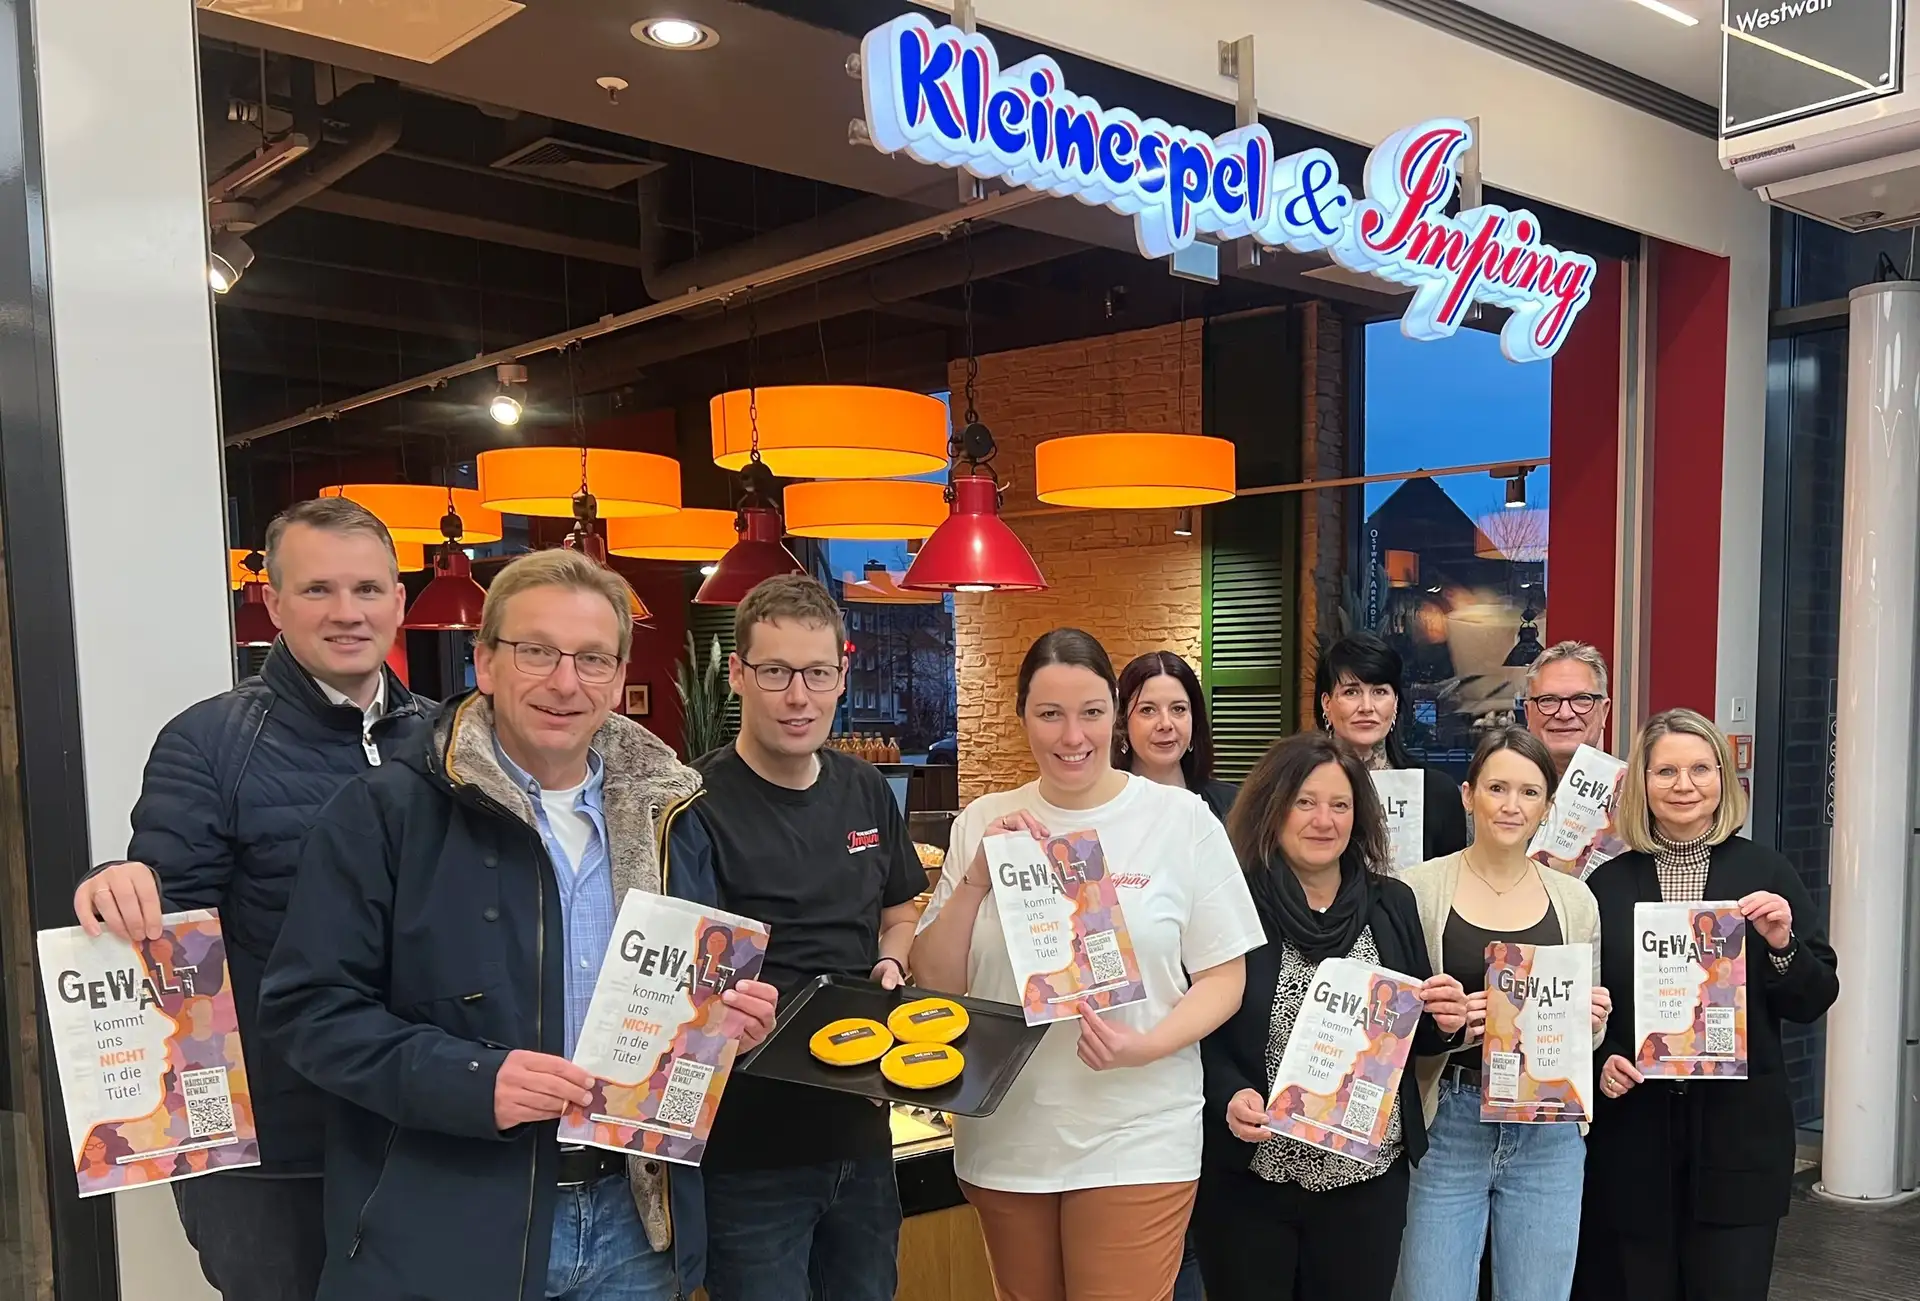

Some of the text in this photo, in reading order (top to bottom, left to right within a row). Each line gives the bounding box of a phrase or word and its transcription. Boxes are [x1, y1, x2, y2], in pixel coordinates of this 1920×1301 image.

[899, 27, 1590, 350] Kleinespel & Imping
[1568, 810, 1580, 820] uns
[1572, 800, 1597, 817] kommt
[1563, 818, 1587, 833] NICHT
[999, 860, 1087, 894] GEWALT
[1024, 897, 1056, 908] kommt
[1027, 912, 1044, 921] uns
[1030, 920, 1060, 934] NICHT
[1032, 934, 1058, 946] in die
[1642, 930, 1726, 964] GEWALT
[620, 929, 735, 994] GEWALT
[1658, 964, 1688, 974] kommt
[58, 962, 199, 1010] GEWALT
[632, 984, 675, 1005] kommt
[1498, 969, 1574, 1008] GEWALT
[1659, 987, 1687, 996] NICHT
[628, 1003, 649, 1016] uns
[1314, 981, 1400, 1033] GEWALT
[1660, 998, 1682, 1008] in die
[94, 1014, 144, 1032] kommt
[1537, 1011, 1566, 1020] kommt
[622, 1017, 662, 1036] NICHT
[1322, 1018, 1353, 1036] kommt
[98, 1036, 122, 1050] uns
[616, 1032, 649, 1050] in die
[1318, 1032, 1334, 1042] uns
[1536, 1034, 1564, 1044] NICHT
[100, 1048, 145, 1068] NICHT
[1314, 1041, 1344, 1059] NICHT
[1536, 1046, 1560, 1055] in die
[1310, 1055, 1335, 1070] in die
[103, 1066, 142, 1084] in die
[105, 1083, 142, 1100] Tüte!
